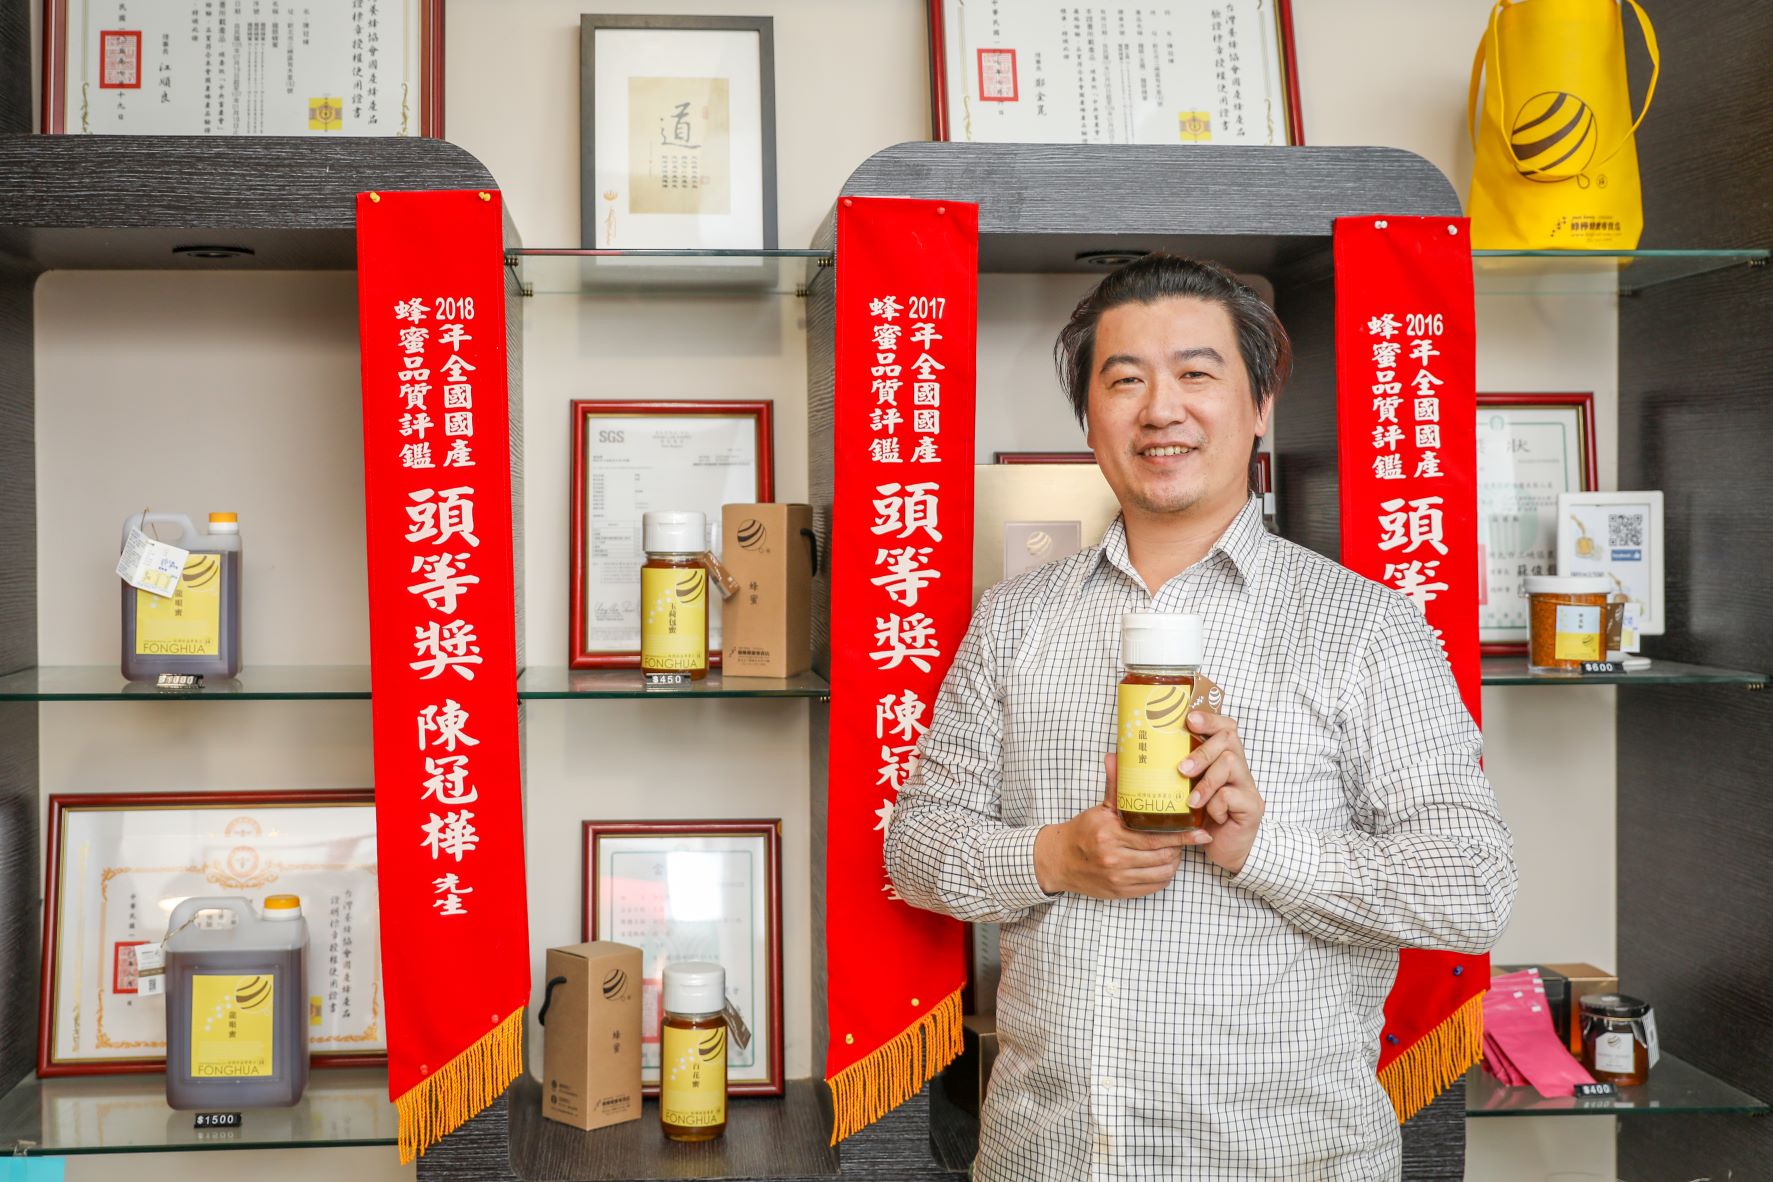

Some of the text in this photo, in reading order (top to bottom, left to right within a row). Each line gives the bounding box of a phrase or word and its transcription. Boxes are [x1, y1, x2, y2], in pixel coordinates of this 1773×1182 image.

[660, 101, 702, 150] 道
[394, 297, 436, 469] 蜂蜜品質評鑑
[433, 296, 477, 468] 2018年全國國產
[868, 295, 904, 464] 蜂蜜品質評鑑
[908, 296, 945, 464] 2017年全國國產
[1367, 313, 1406, 480] 蜂蜜品質評鑑
[1404, 313, 1444, 479] 2016年全國國產
[599, 430, 624, 443] SGS
[869, 481, 943, 674] 頭等獎
[143, 643, 205, 654] FONGHUA
[644, 657, 698, 668] FONGHUA
[1585, 662, 1614, 672] $600
[652, 675, 682, 684] $450
[404, 486, 483, 916] 頭等獎 陳冠樺 先生
[1138, 729, 1148, 765] 龍眼蜜
[198, 1064, 260, 1076] FONGHUA
[196, 1114, 234, 1125] $1500
[665, 1111, 718, 1125] FONGHUA
